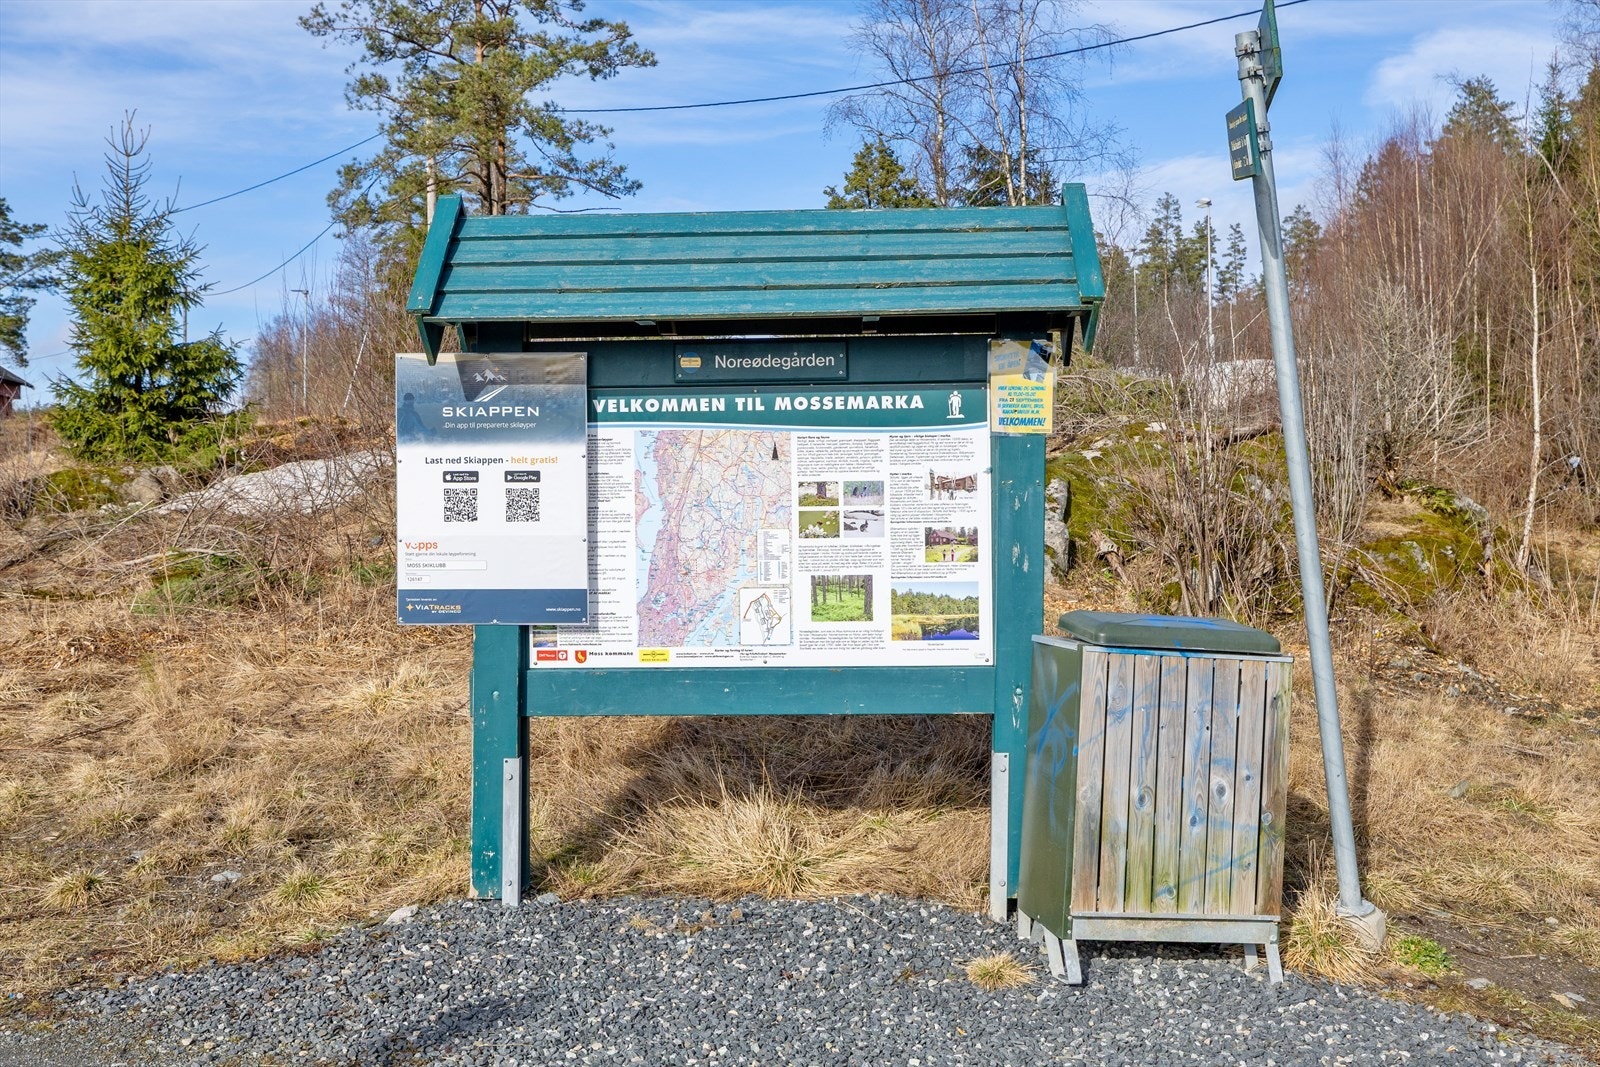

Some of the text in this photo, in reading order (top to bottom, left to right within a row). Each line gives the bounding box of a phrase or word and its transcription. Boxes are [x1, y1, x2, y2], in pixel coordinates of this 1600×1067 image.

[715, 353, 835, 370] Noreødegården
[592, 395, 924, 413] VELKOMMEN TIL MOSSEMARKA
[442, 406, 540, 417] SKIAPPEN
[476, 422, 509, 430] preparerte
[510, 421, 537, 430] skiløyper
[998, 417, 1046, 427] VELKOMMEN!
[425, 456, 443, 465] Last
[445, 456, 462, 465] ned
[463, 456, 504, 467] Skiappen
[510, 456, 530, 464] helt
[530, 456, 558, 466] gratis!
